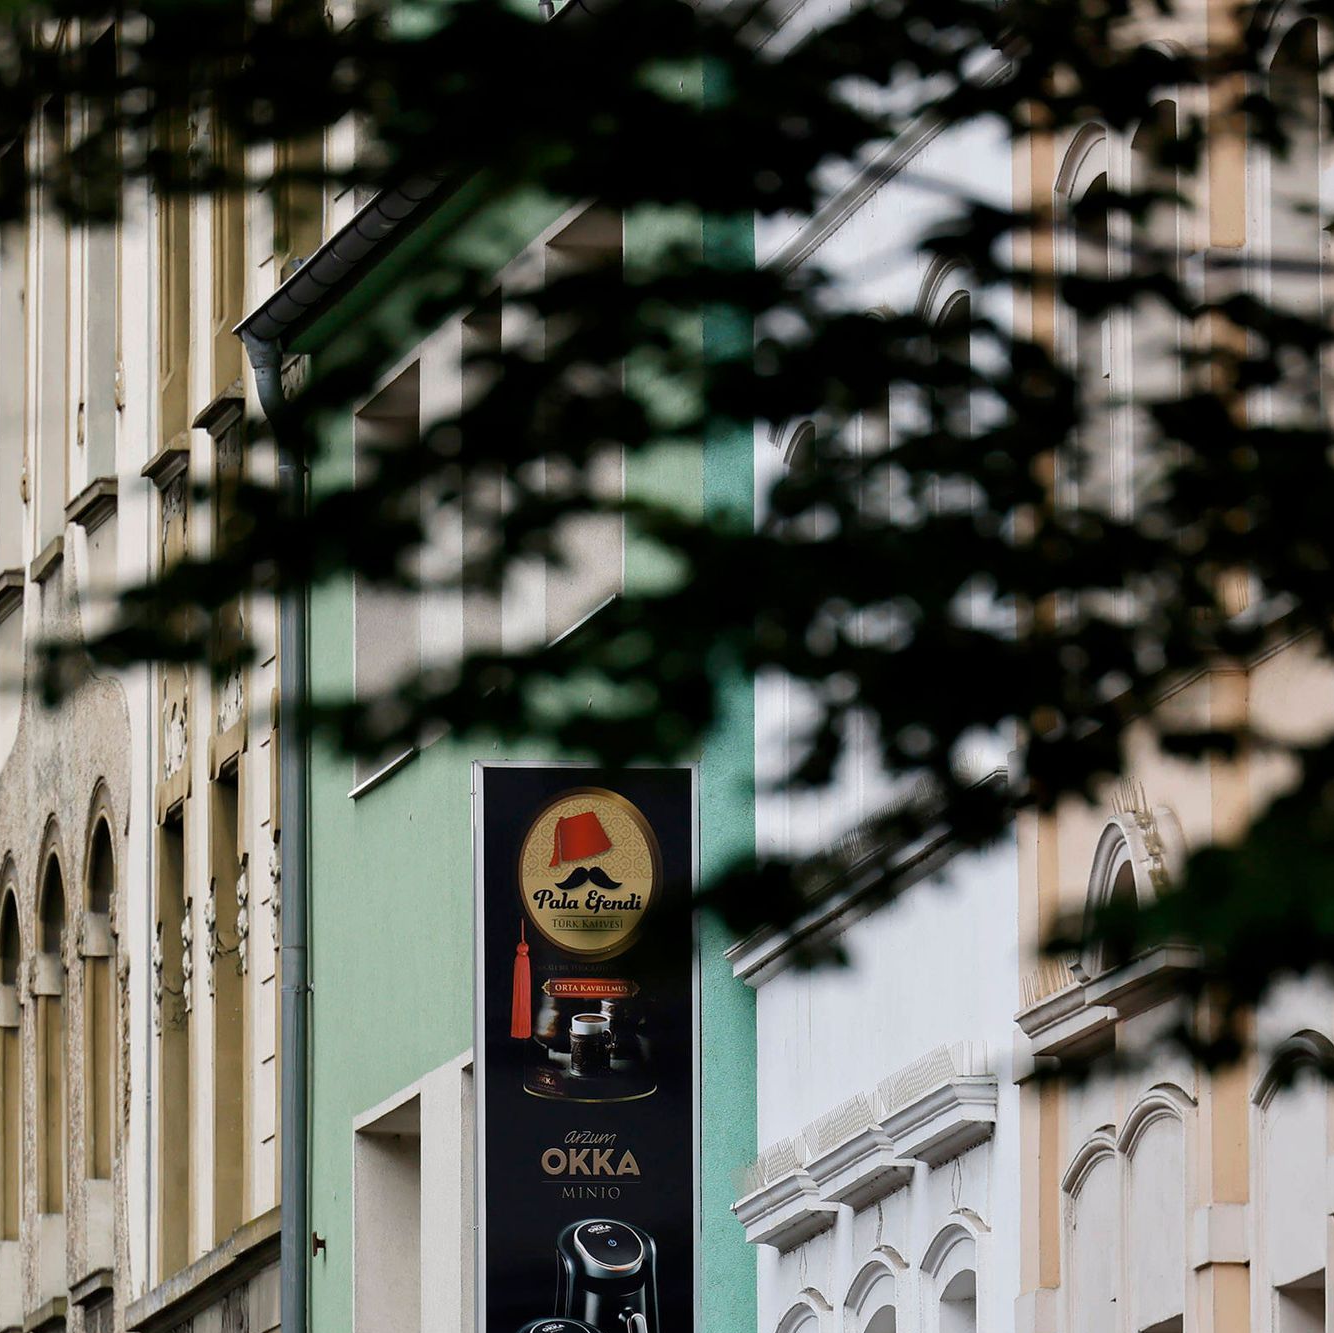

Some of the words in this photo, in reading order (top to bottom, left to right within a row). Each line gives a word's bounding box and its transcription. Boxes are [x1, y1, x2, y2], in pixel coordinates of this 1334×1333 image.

[533, 889, 580, 910] Pala
[584, 890, 642, 914] Efendi
[552, 917, 579, 929] TÜRK
[554, 983, 578, 992] ORTA
[564, 1130, 617, 1146] arzum
[541, 1147, 641, 1176] OKKA
[562, 1186, 621, 1200] MINIO
